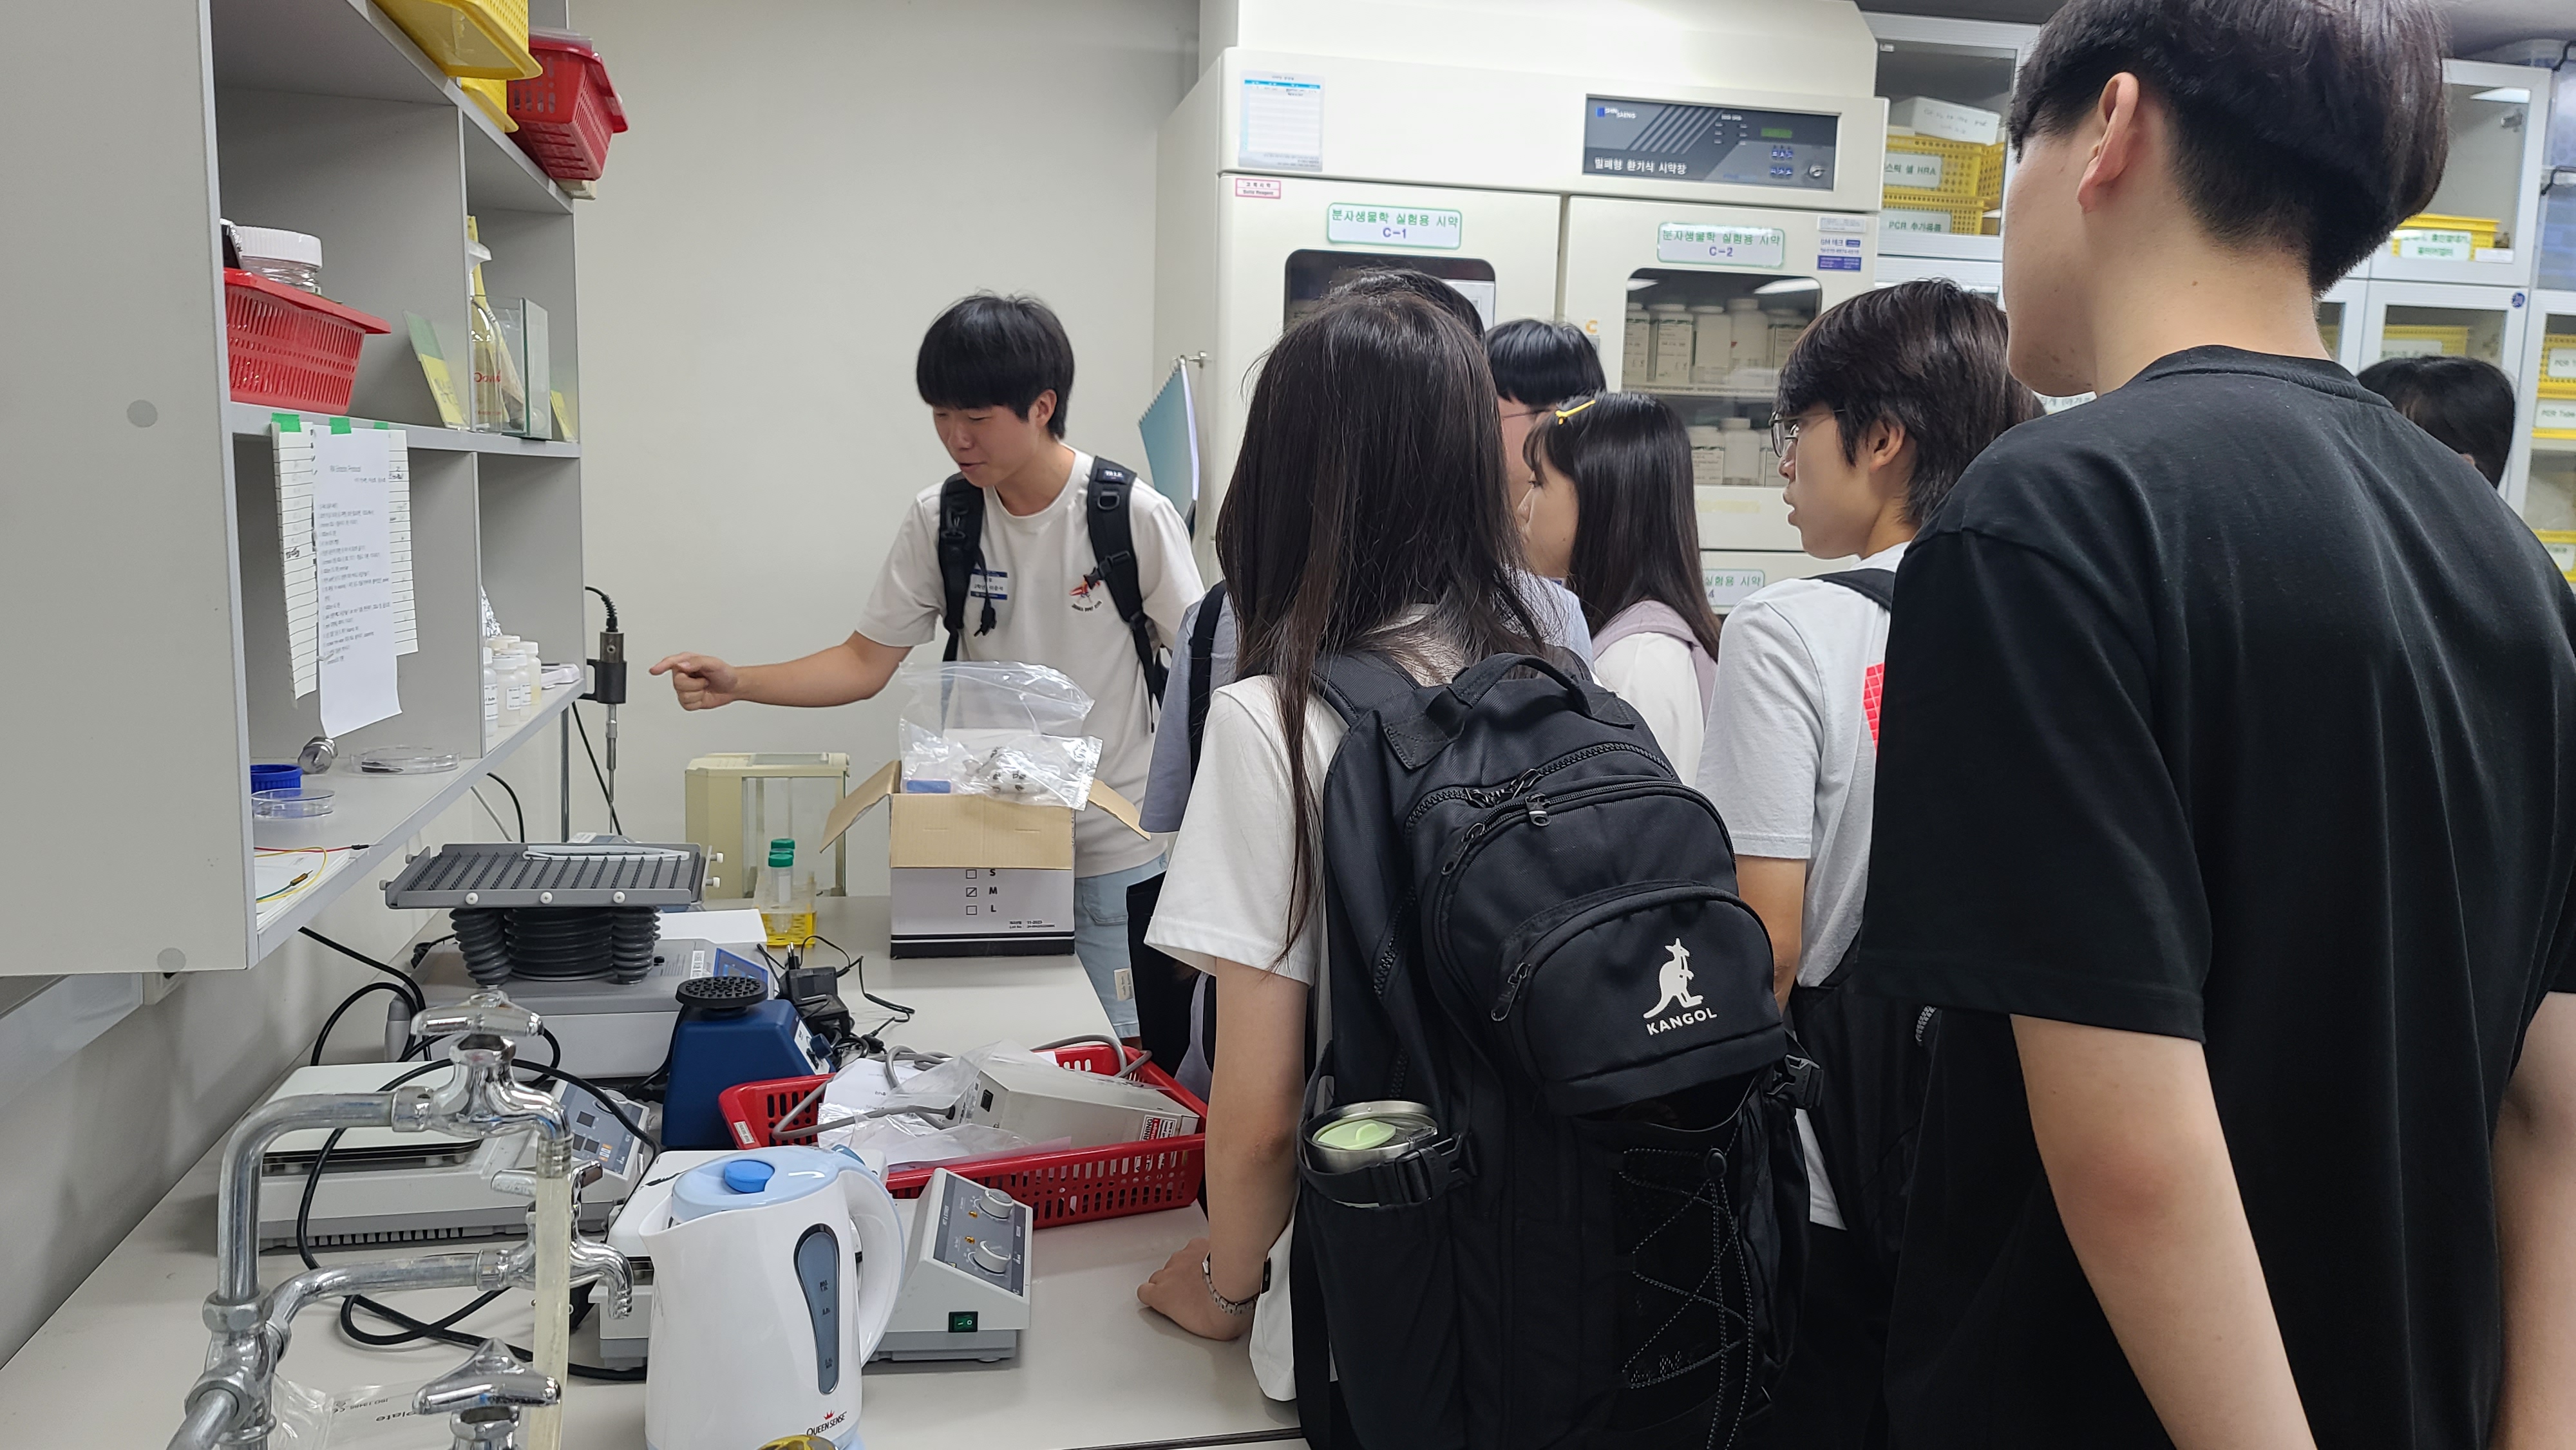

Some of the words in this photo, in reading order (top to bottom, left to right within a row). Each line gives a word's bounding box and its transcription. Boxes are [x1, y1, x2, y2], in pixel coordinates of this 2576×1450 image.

[1595, 156, 1623, 171] 밀폐형
[1627, 159, 1654, 173] 환기식
[1658, 161, 1687, 175] 시약장
[1332, 209, 1388, 223] 분자생물학
[1396, 212, 1430, 227] 실험용
[1436, 216, 1458, 229] 시약
[1383, 227, 1406, 239] C-1
[1663, 230, 1716, 243] 분자생물학
[1722, 232, 1753, 245] 실험용
[1759, 236, 1780, 247] 시약
[1709, 246, 1734, 258] C-2
[1740, 576, 1761, 587] 시약
[989, 869, 996, 877] S
[989, 887, 998, 895] M
[990, 904, 997, 912] L
[1646, 1007, 1718, 1036] KANGOL
[1142, 1118, 1153, 1140] RNING
[806, 1422, 829, 1436] QUEEN
[829, 1411, 847, 1428] SENSE
